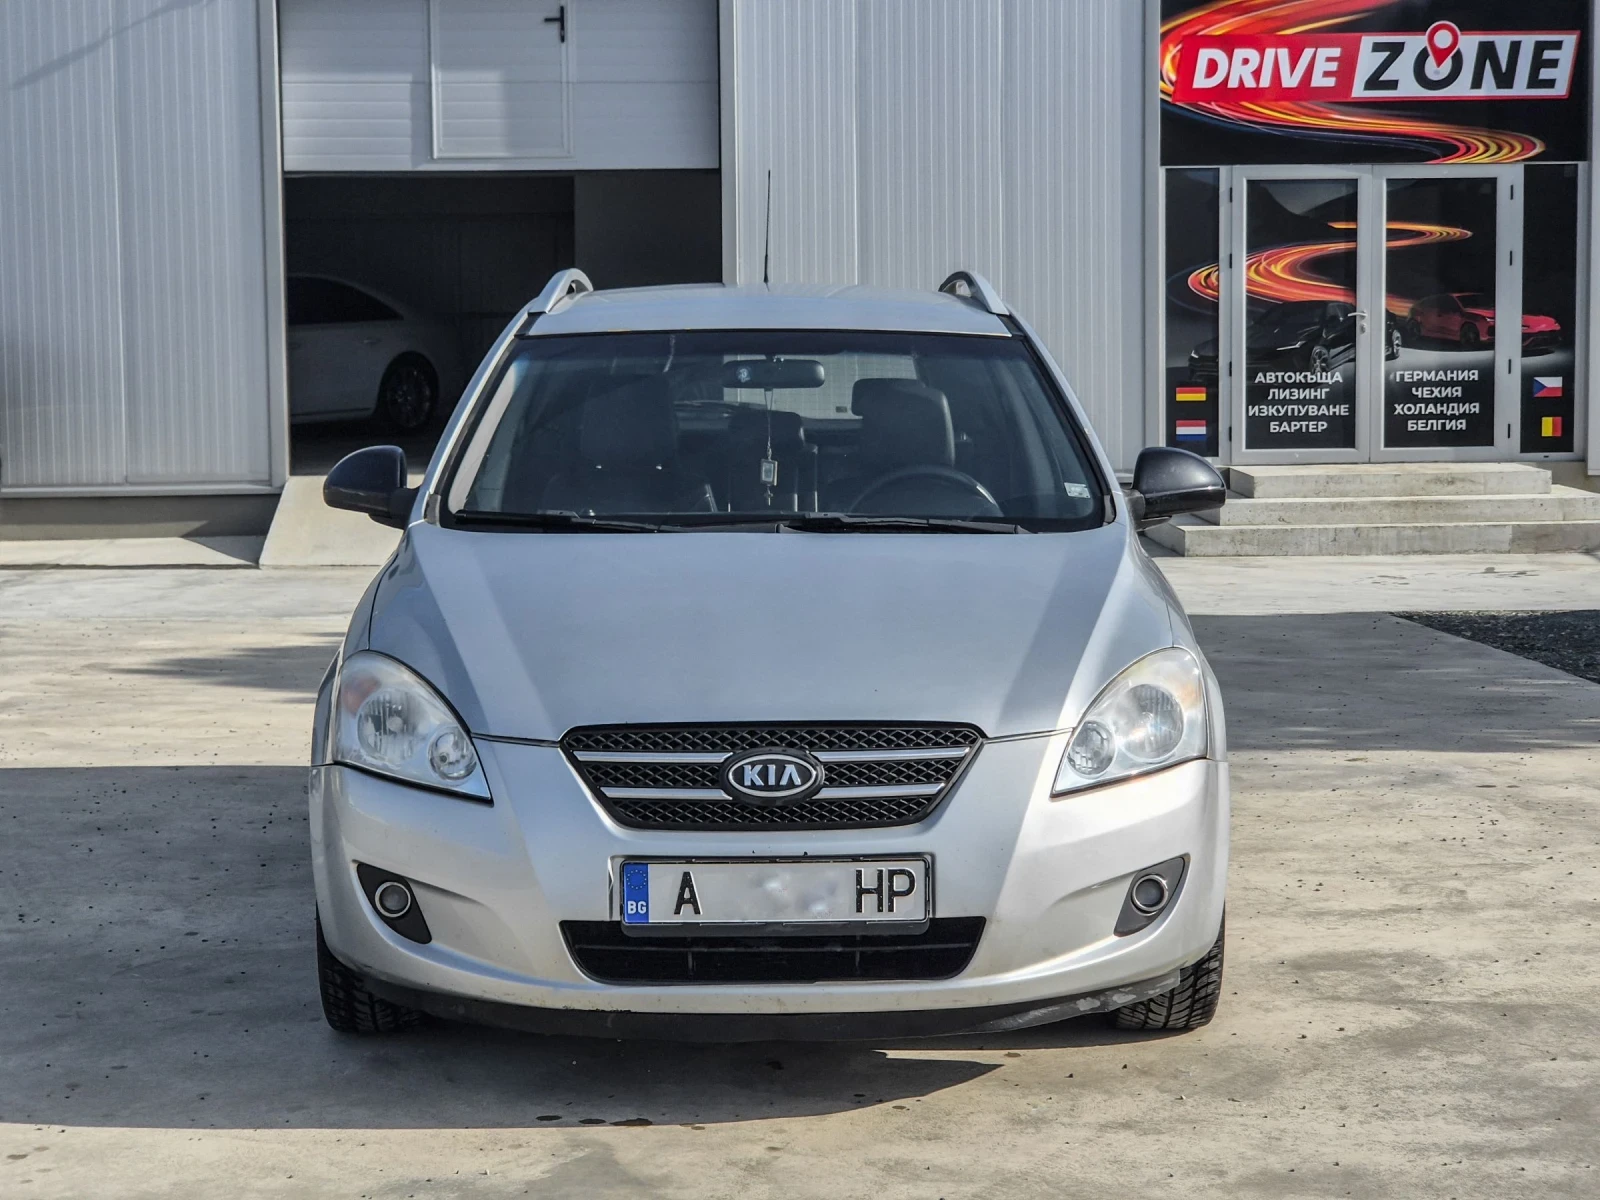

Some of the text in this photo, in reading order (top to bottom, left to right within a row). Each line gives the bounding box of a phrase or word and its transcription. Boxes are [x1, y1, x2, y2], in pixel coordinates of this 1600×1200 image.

[1192, 40, 1564, 91] DRIVE ZONE
[1254, 371, 1343, 385] АВТОКЪЩА
[1395, 369, 1479, 383] ГЕРМАНИЯ
[1267, 387, 1330, 401] ЛИЗИНГ
[1411, 386, 1462, 399] ЧЕХИЯ
[1247, 405, 1349, 418] ИЗКУПУВАНЕ
[1393, 403, 1480, 416] ХОЛАНДИЯ
[1269, 421, 1328, 433] БАРТЕР
[1407, 418, 1467, 432] БЕЛГИЯ
[743, 764, 802, 787] KIA
[627, 900, 647, 914] BG
